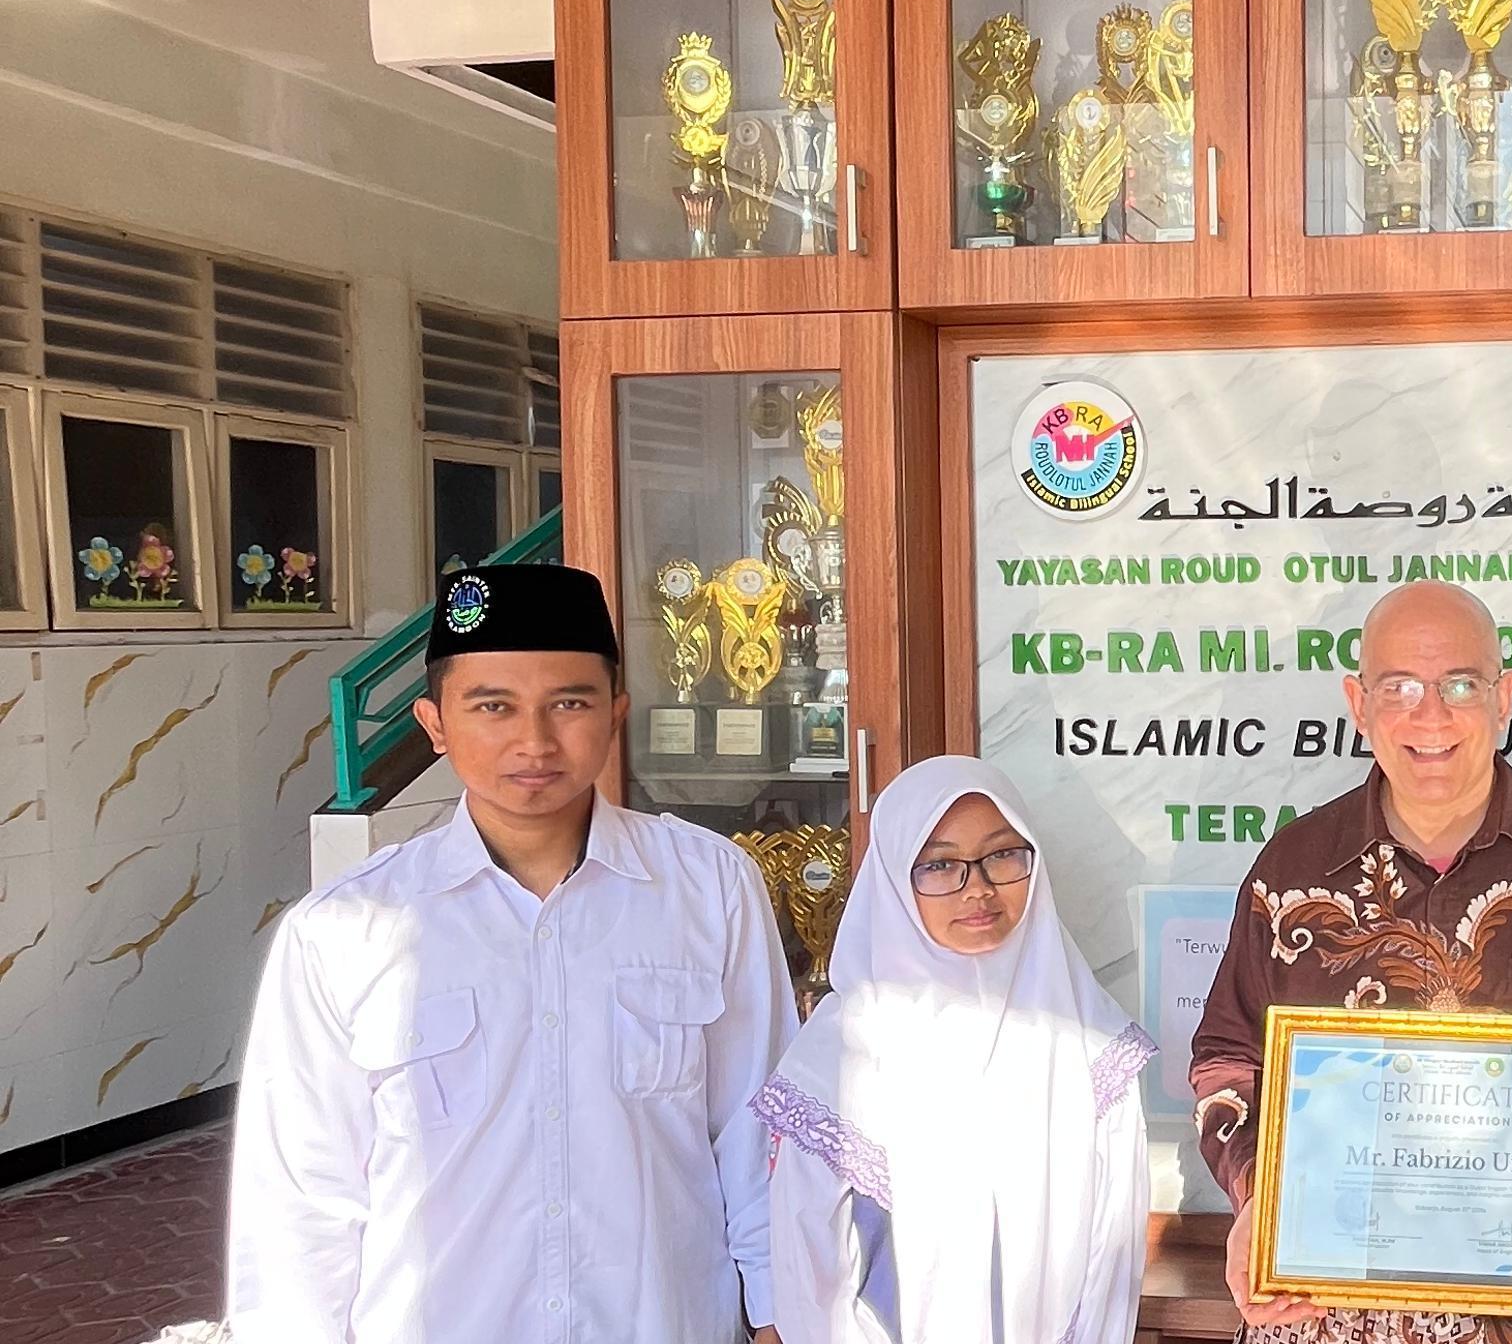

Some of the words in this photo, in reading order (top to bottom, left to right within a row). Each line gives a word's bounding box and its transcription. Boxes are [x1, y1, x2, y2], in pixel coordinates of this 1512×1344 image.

[1042, 408, 1069, 434] KB
[1075, 406, 1104, 431] RA
[1026, 474, 1067, 509] Islamic
[1069, 478, 1123, 510] Bilingual
[1120, 431, 1137, 478] School
[1034, 442, 1087, 491] ROUDLOTUL
[1090, 442, 1118, 487] JANNAH
[997, 558, 1150, 586] YAYASAN
[1161, 556, 1262, 584] ROUD
[1284, 554, 1378, 583] OTUL
[1011, 629, 1184, 675] KB-RA
[1200, 630, 1285, 673] MI.
[1055, 717, 1266, 758] ISLAMIC
[1384, 1111, 1401, 1122] OF
[1407, 1113, 1512, 1127] APPRECIATION
[1345, 1144, 1387, 1168] Mr.
[1392, 1147, 1486, 1172] Fabrizio
